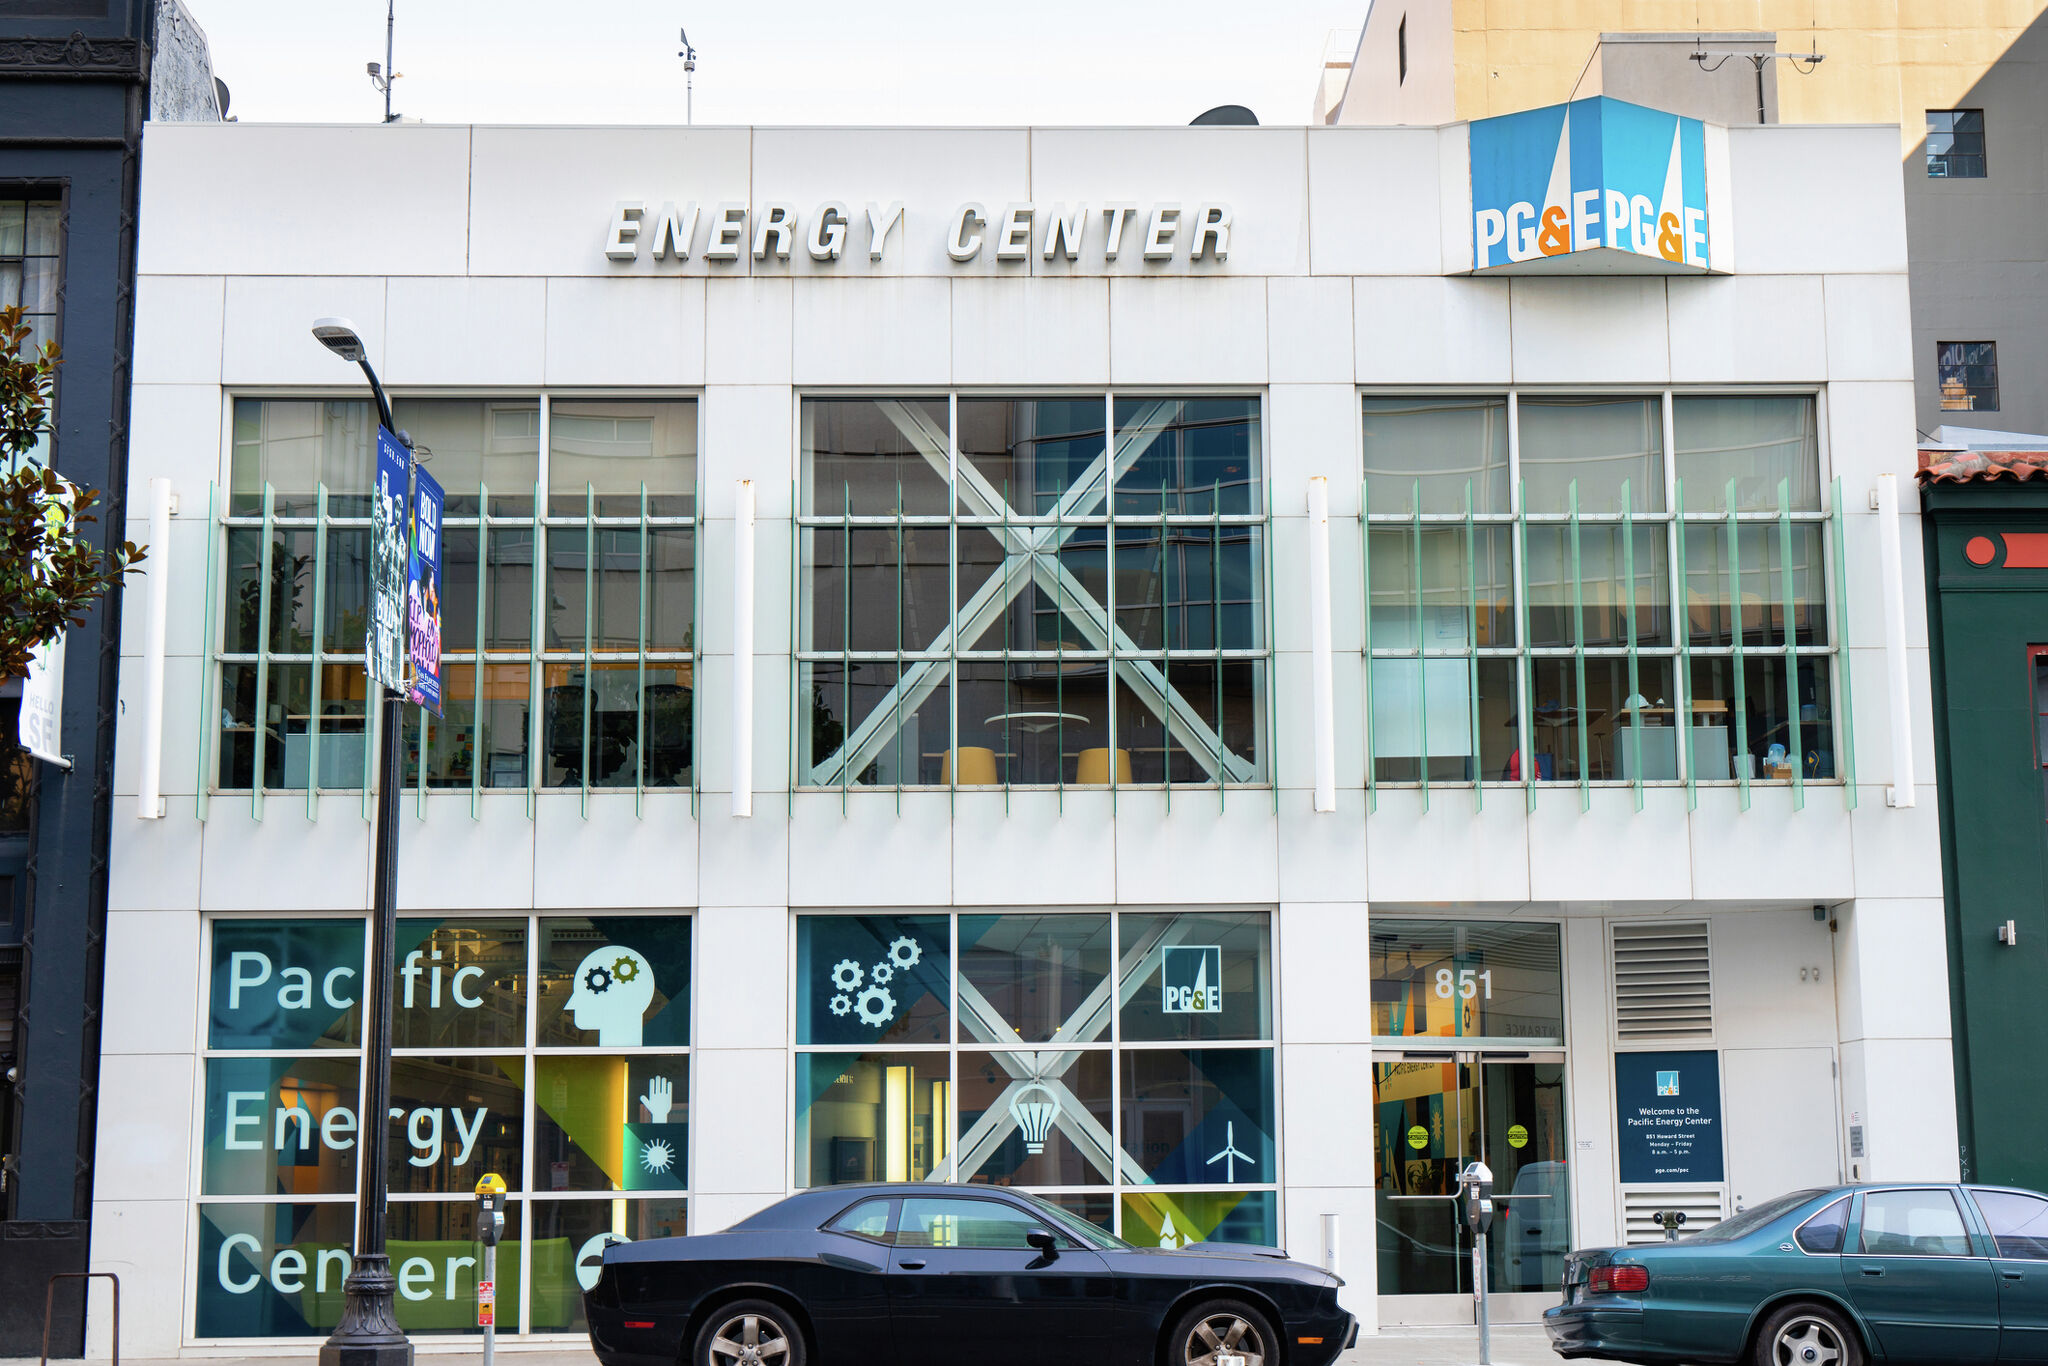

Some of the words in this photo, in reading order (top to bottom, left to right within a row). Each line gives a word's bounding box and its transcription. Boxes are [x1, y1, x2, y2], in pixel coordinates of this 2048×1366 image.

[605, 200, 904, 260] ENERGY
[947, 201, 1232, 261] CENTER
[1475, 188, 1600, 269] PG&E
[1605, 188, 1709, 269] PG&E
[420, 490, 437, 531] BOLD
[418, 520, 436, 562] NOW
[29, 692, 54, 714] HELLO
[29, 712, 53, 752] SF
[228, 950, 486, 1009] Pacfic
[1166, 985, 1219, 1010] PG&E
[1435, 968, 1492, 1000] 851
[1657, 1085, 1679, 1095] PG&E
[1627, 1118, 1654, 1126] Pacific
[1655, 1117, 1684, 1127] Energy
[1685, 1117, 1712, 1125] Center
[1686, 1107, 1700, 1115] the
[217, 1233, 477, 1301] Cener
